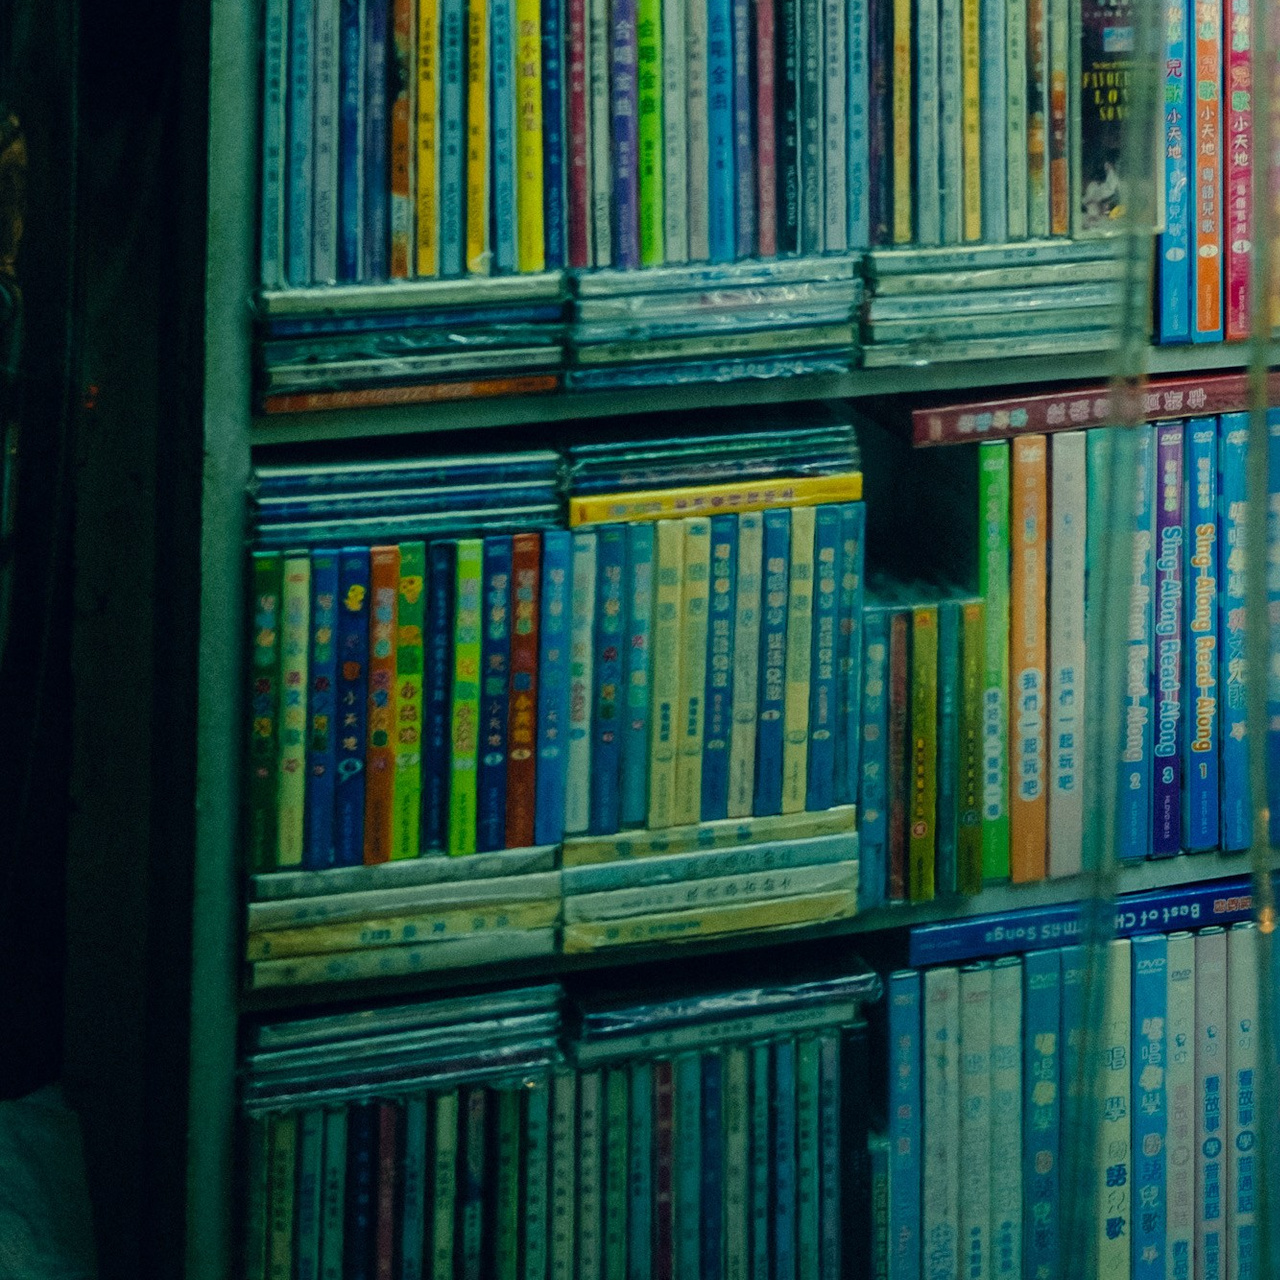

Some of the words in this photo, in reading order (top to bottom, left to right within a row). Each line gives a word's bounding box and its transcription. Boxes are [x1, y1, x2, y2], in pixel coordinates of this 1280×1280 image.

[1165, 58, 1184, 159] 兒歌小天地
[1195, 54, 1217, 156] 兒歌小天地
[1230, 61, 1251, 167] 兒歌小天地
[1156, 525, 1183, 635] Sing-Along
[1190, 523, 1216, 632] Sing-Along
[1022, 672, 1039, 797] 我們一起玩吧
[1057, 666, 1075, 791] 我們一起玩吧
[1155, 638, 1181, 758] Read-Along
[1190, 635, 1216, 754] Read-Along
[1161, 766, 1174, 784] 3
[1198, 762, 1207, 779] 1
[984, 926, 1037, 943] Songs
[1140, 910, 1159, 928] of
[1162, 902, 1201, 923] Best
[1138, 1016, 1164, 1118] 唱唱學學
[1139, 1132, 1164, 1234] 國語兒歌
